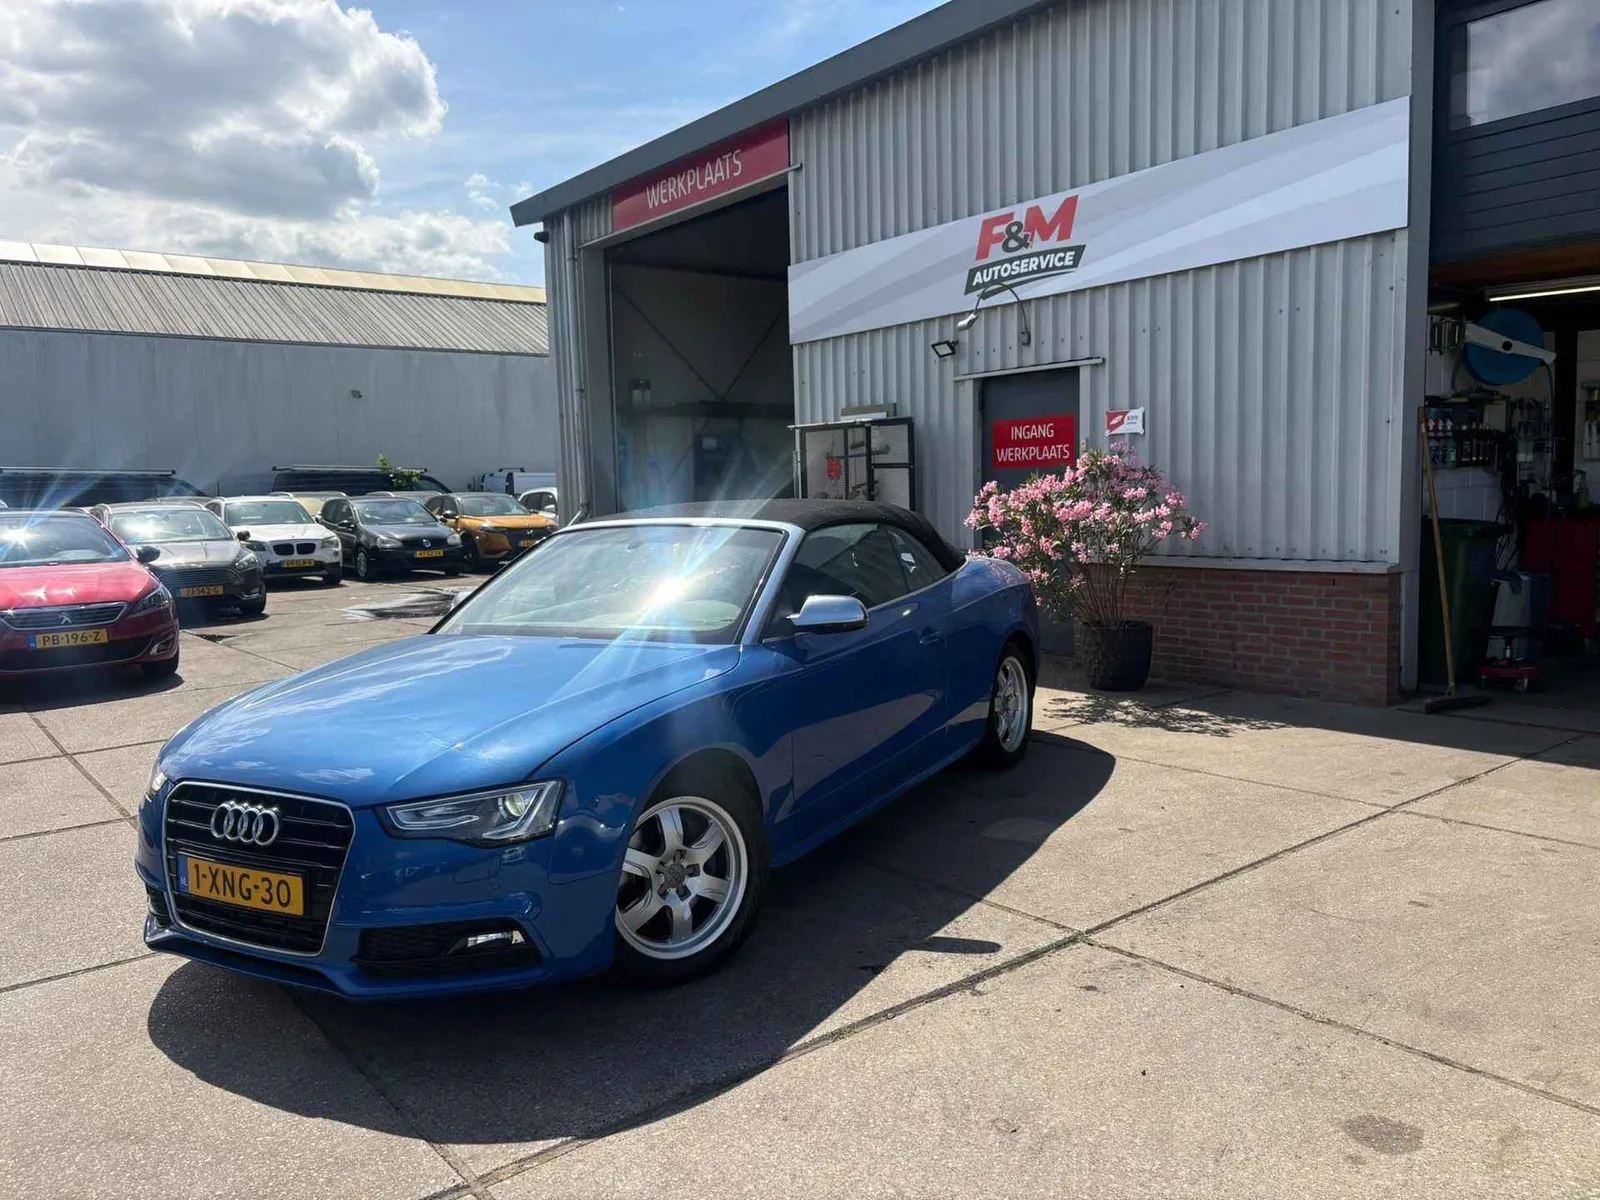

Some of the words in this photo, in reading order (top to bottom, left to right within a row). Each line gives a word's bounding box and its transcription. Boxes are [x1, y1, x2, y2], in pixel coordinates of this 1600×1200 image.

[646, 150, 742, 209] WERKPLAATS
[975, 195, 1079, 261] F&M
[972, 251, 1076, 286] AUTOSERVICE
[1010, 423, 1055, 440] INGANG
[996, 444, 1070, 462] WERKPLAATS
[42, 631, 101, 646] PB-196-Z
[194, 863, 292, 908] 1-XNG-30
